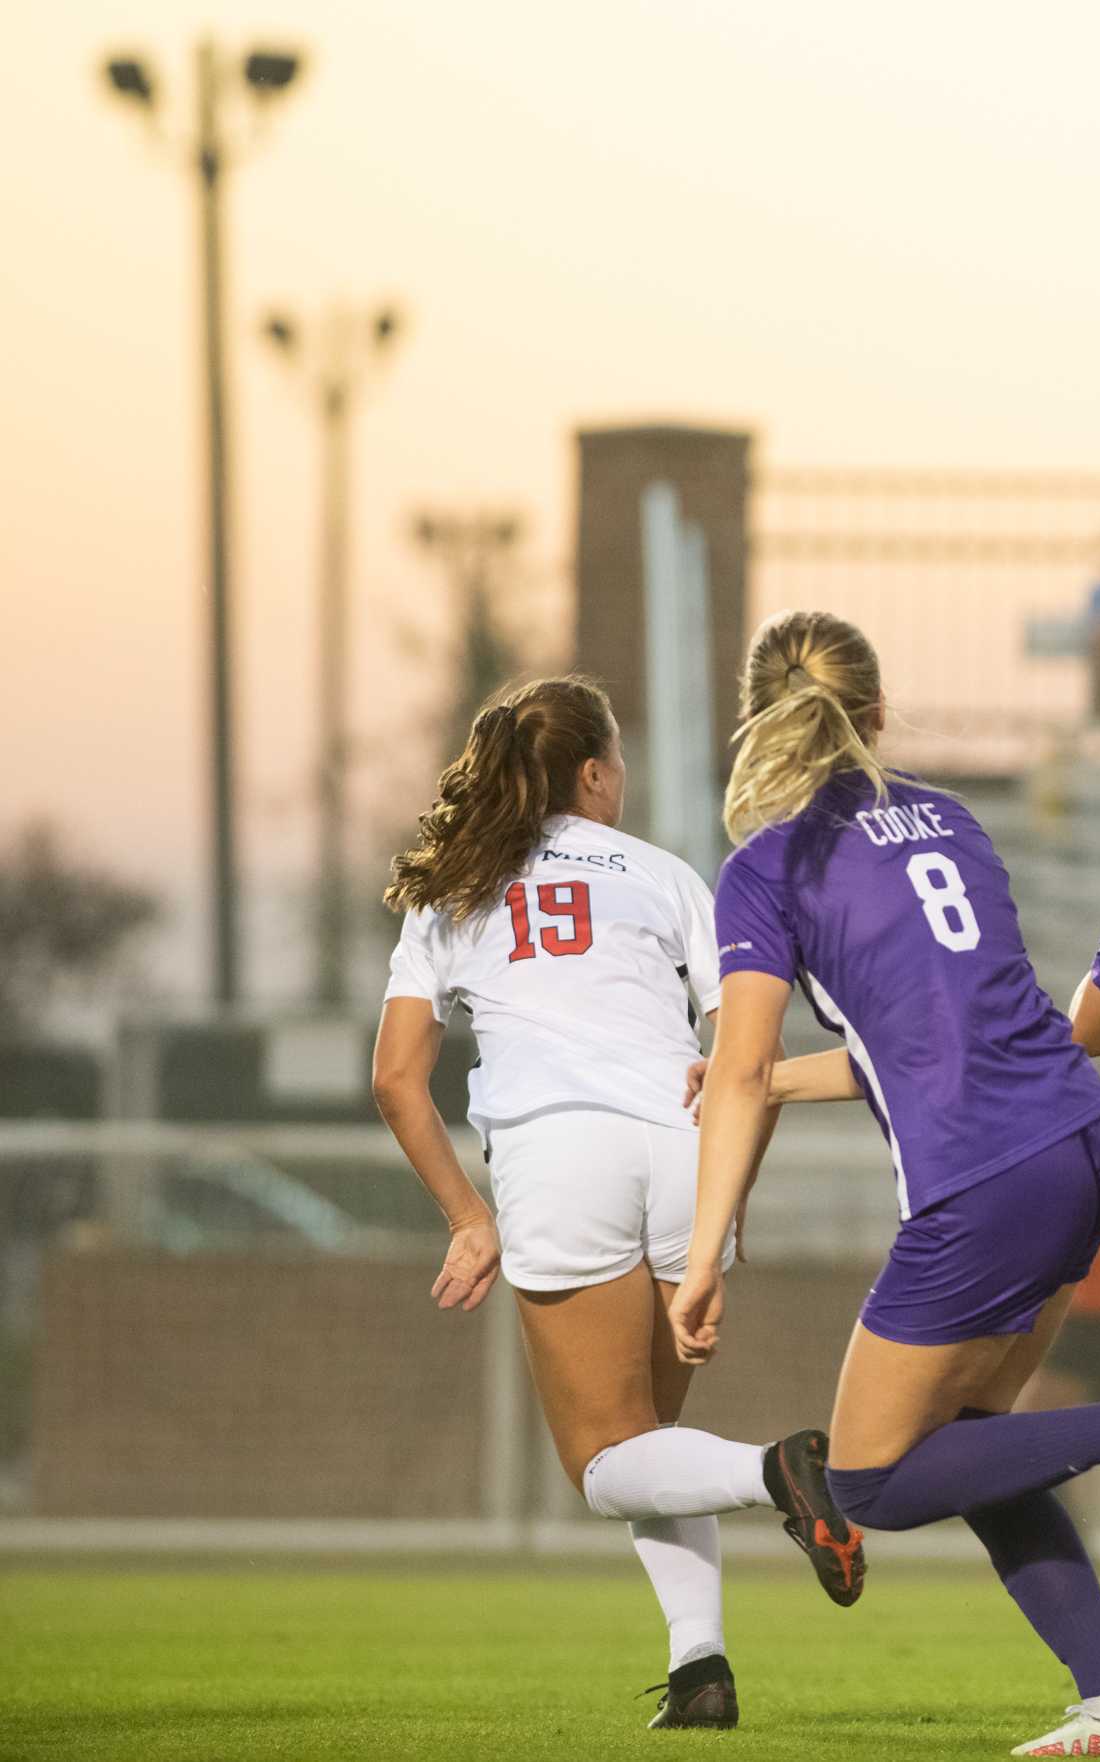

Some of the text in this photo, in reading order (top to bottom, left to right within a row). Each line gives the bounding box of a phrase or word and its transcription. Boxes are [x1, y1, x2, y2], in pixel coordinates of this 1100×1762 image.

[856, 803, 954, 846] COOKE
[505, 880, 593, 963] 19
[906, 851, 981, 952] 8
